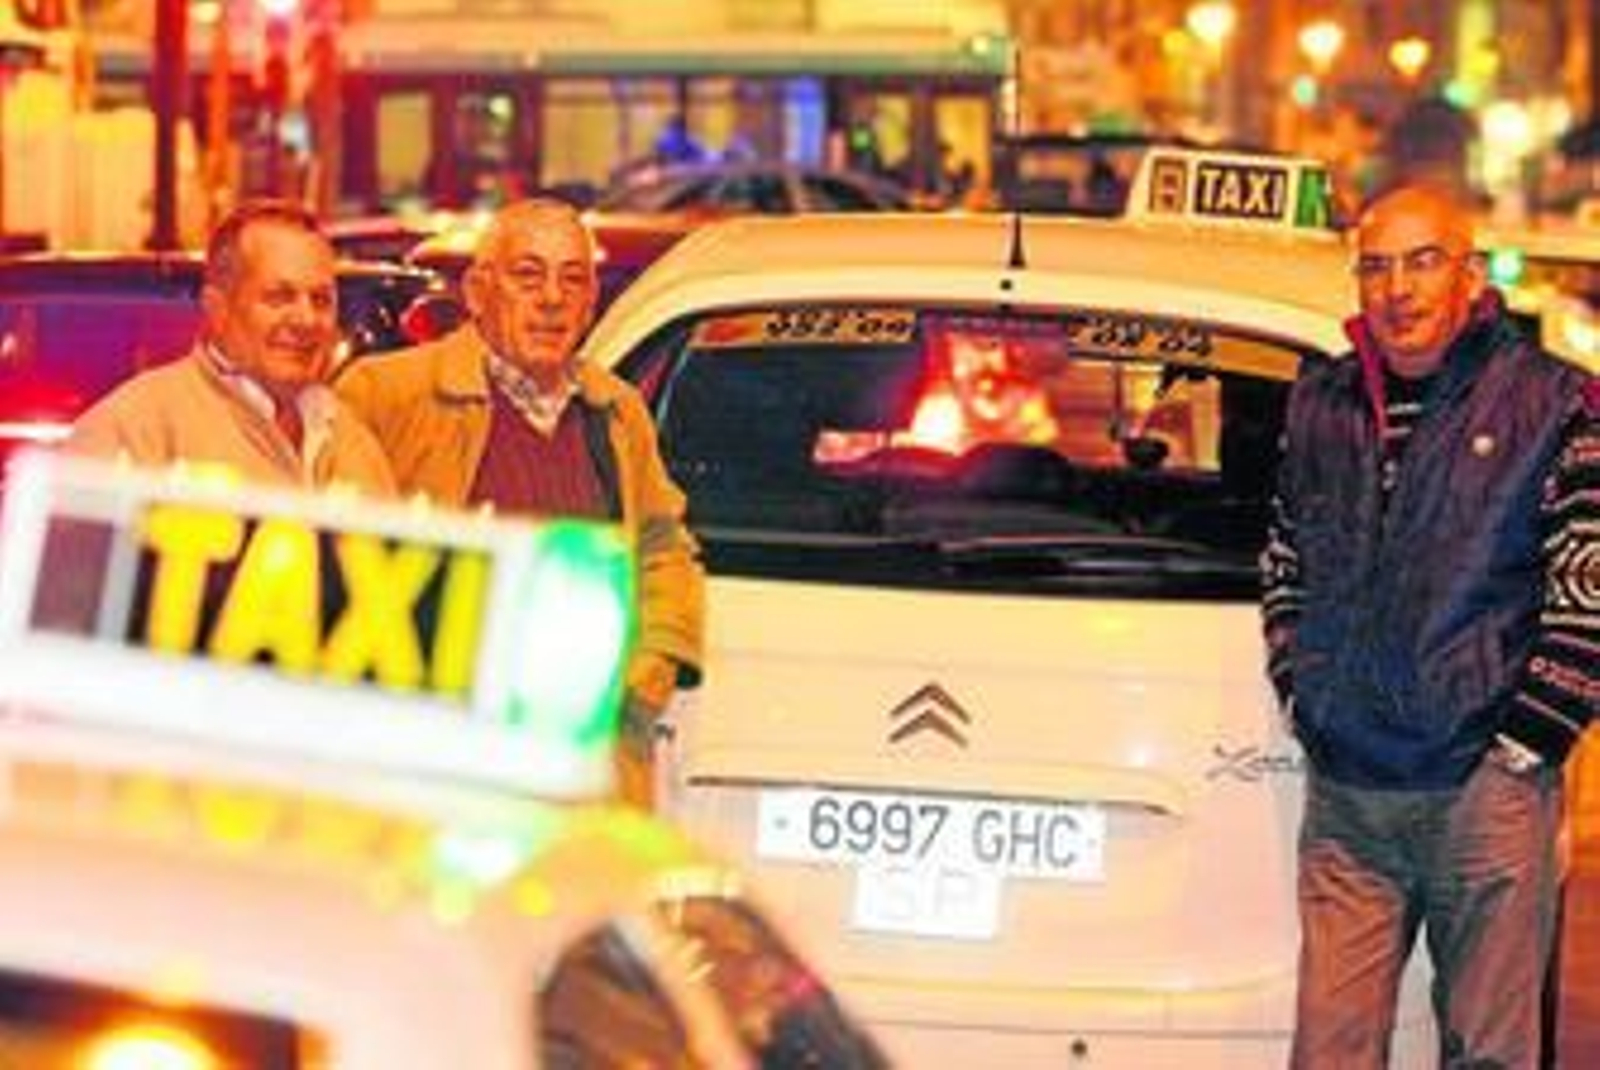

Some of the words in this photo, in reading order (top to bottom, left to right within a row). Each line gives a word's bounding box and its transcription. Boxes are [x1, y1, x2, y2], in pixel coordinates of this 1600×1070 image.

[1199, 168, 1284, 214] TAXI
[140, 505, 492, 696] TAXI
[809, 797, 950, 859] 6997
[972, 808, 1080, 868] GHC
